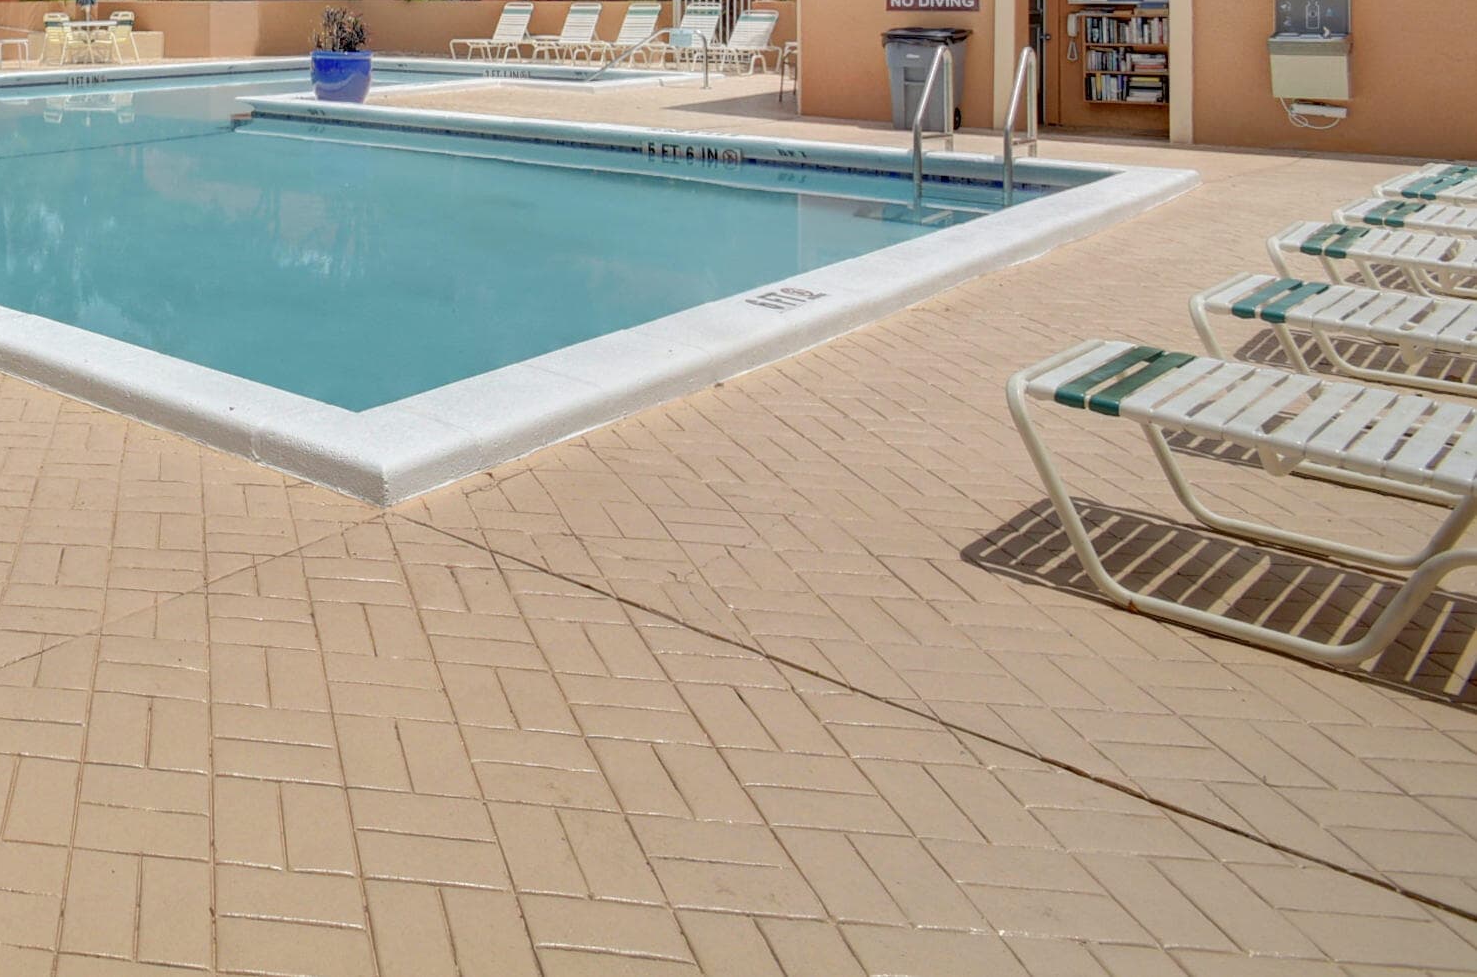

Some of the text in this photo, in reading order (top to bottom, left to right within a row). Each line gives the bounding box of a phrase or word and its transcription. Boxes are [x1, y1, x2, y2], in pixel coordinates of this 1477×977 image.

[648, 142, 718, 160] 5 FT 6 IN
